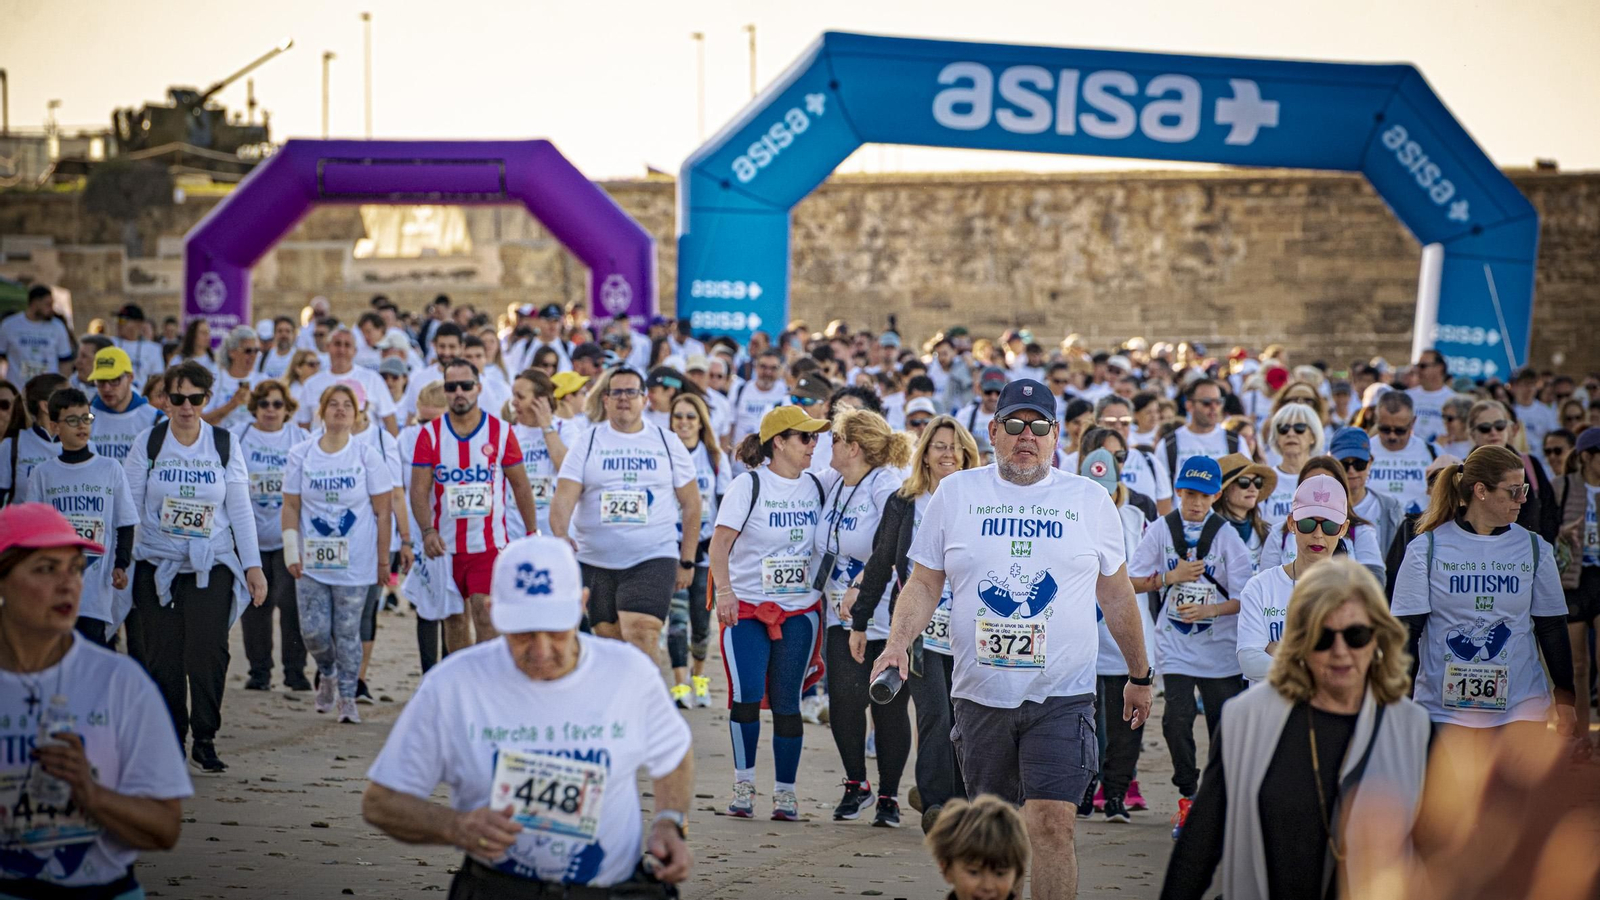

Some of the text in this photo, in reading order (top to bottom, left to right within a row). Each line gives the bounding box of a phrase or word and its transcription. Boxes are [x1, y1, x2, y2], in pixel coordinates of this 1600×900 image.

[932, 61, 1201, 143] asisa
[731, 107, 810, 183] asisa
[1381, 125, 1455, 205] asisa
[690, 280, 748, 300] asisa
[690, 311, 748, 330] asisa
[433, 463, 495, 483] Gosbi
[602, 457, 657, 471] AUTISMO
[159, 469, 216, 484] AUTISMO
[309, 476, 356, 491] AUTISMO
[1369, 468, 1423, 481] AUTISMO
[52, 496, 104, 513] AUTISMO
[456, 493, 485, 508] 872
[610, 501, 639, 514] 243
[764, 498, 788, 509] marcha
[790, 500, 796, 508] a
[172, 509, 203, 527] 758
[769, 511, 818, 528] AUTISMO
[969, 503, 1079, 522] I marcha a favor del
[981, 517, 1063, 539] AUTISMO
[316, 548, 335, 561] 80
[1443, 560, 1476, 571] marcha
[1480, 562, 1486, 571] a
[1491, 560, 1516, 571] favor
[774, 568, 805, 584] 829
[987, 570, 1011, 591] Cada
[1449, 574, 1520, 594] AUTISMO
[1263, 607, 1286, 617] marc
[925, 620, 950, 638] 83
[989, 634, 1032, 655] 372
[1457, 677, 1496, 698] 136
[563, 721, 603, 741] favor
[515, 777, 580, 814] 448
